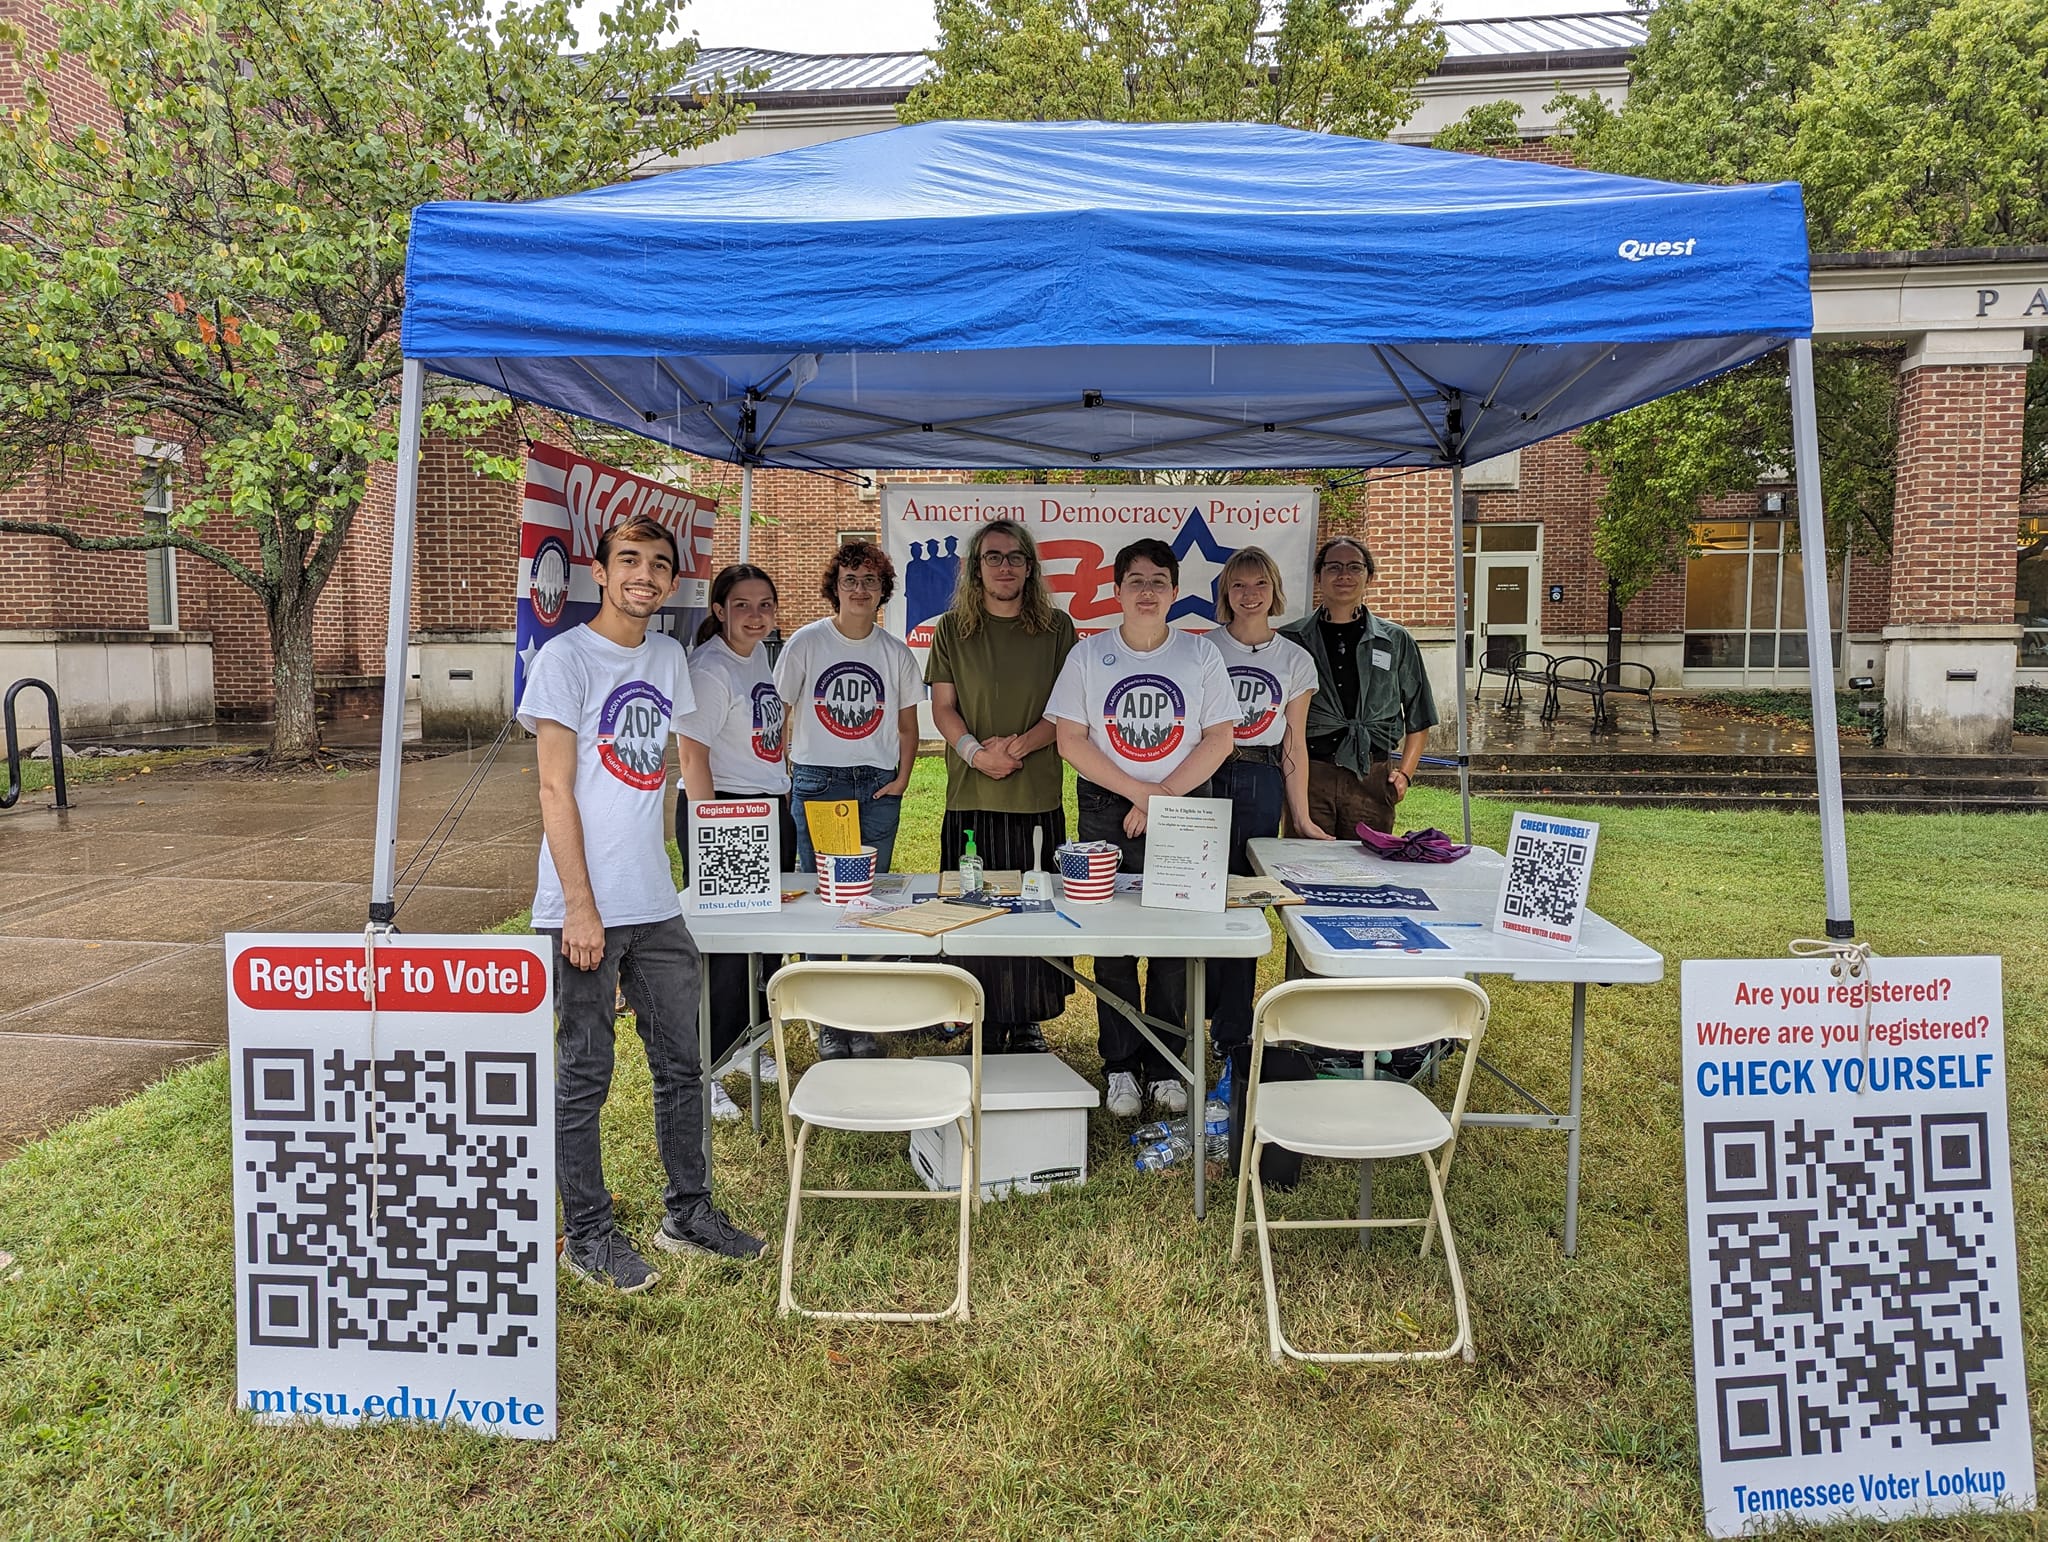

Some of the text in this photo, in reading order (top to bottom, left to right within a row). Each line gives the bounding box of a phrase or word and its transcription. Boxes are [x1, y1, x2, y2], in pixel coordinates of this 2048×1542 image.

[1618, 238, 1697, 262] Quest
[902, 498, 1300, 530] American Democracy Project
[832, 678, 872, 702] ADP
[1123, 678, 1146, 688] American
[1146, 678, 1173, 692] Democracy
[1231, 678, 1267, 704] DP
[762, 696, 782, 728] ADP
[1122, 692, 1169, 719] ADP
[621, 705, 662, 739] ADP
[1147, 750, 1161, 758] State
[1160, 732, 1181, 753] University
[700, 804, 767, 816] Register to Vote!
[1520, 818, 1592, 839] CHECK YOURSELF
[699, 899, 773, 910] mtsu.edu/vote
[1502, 920, 1572, 943] TENNESSEE VOTER LOOKUP
[249, 957, 530, 999] Register to Vote!
[1735, 978, 1951, 1009] Are you registered?
[1696, 1015, 1989, 1048] Where are you registered?
[1696, 1053, 1993, 1097] CHECK YOURSELF
[247, 1385, 545, 1429] mtsu.edu/vote
[1734, 1467, 2006, 1514] Tennessee Voter Lookup
